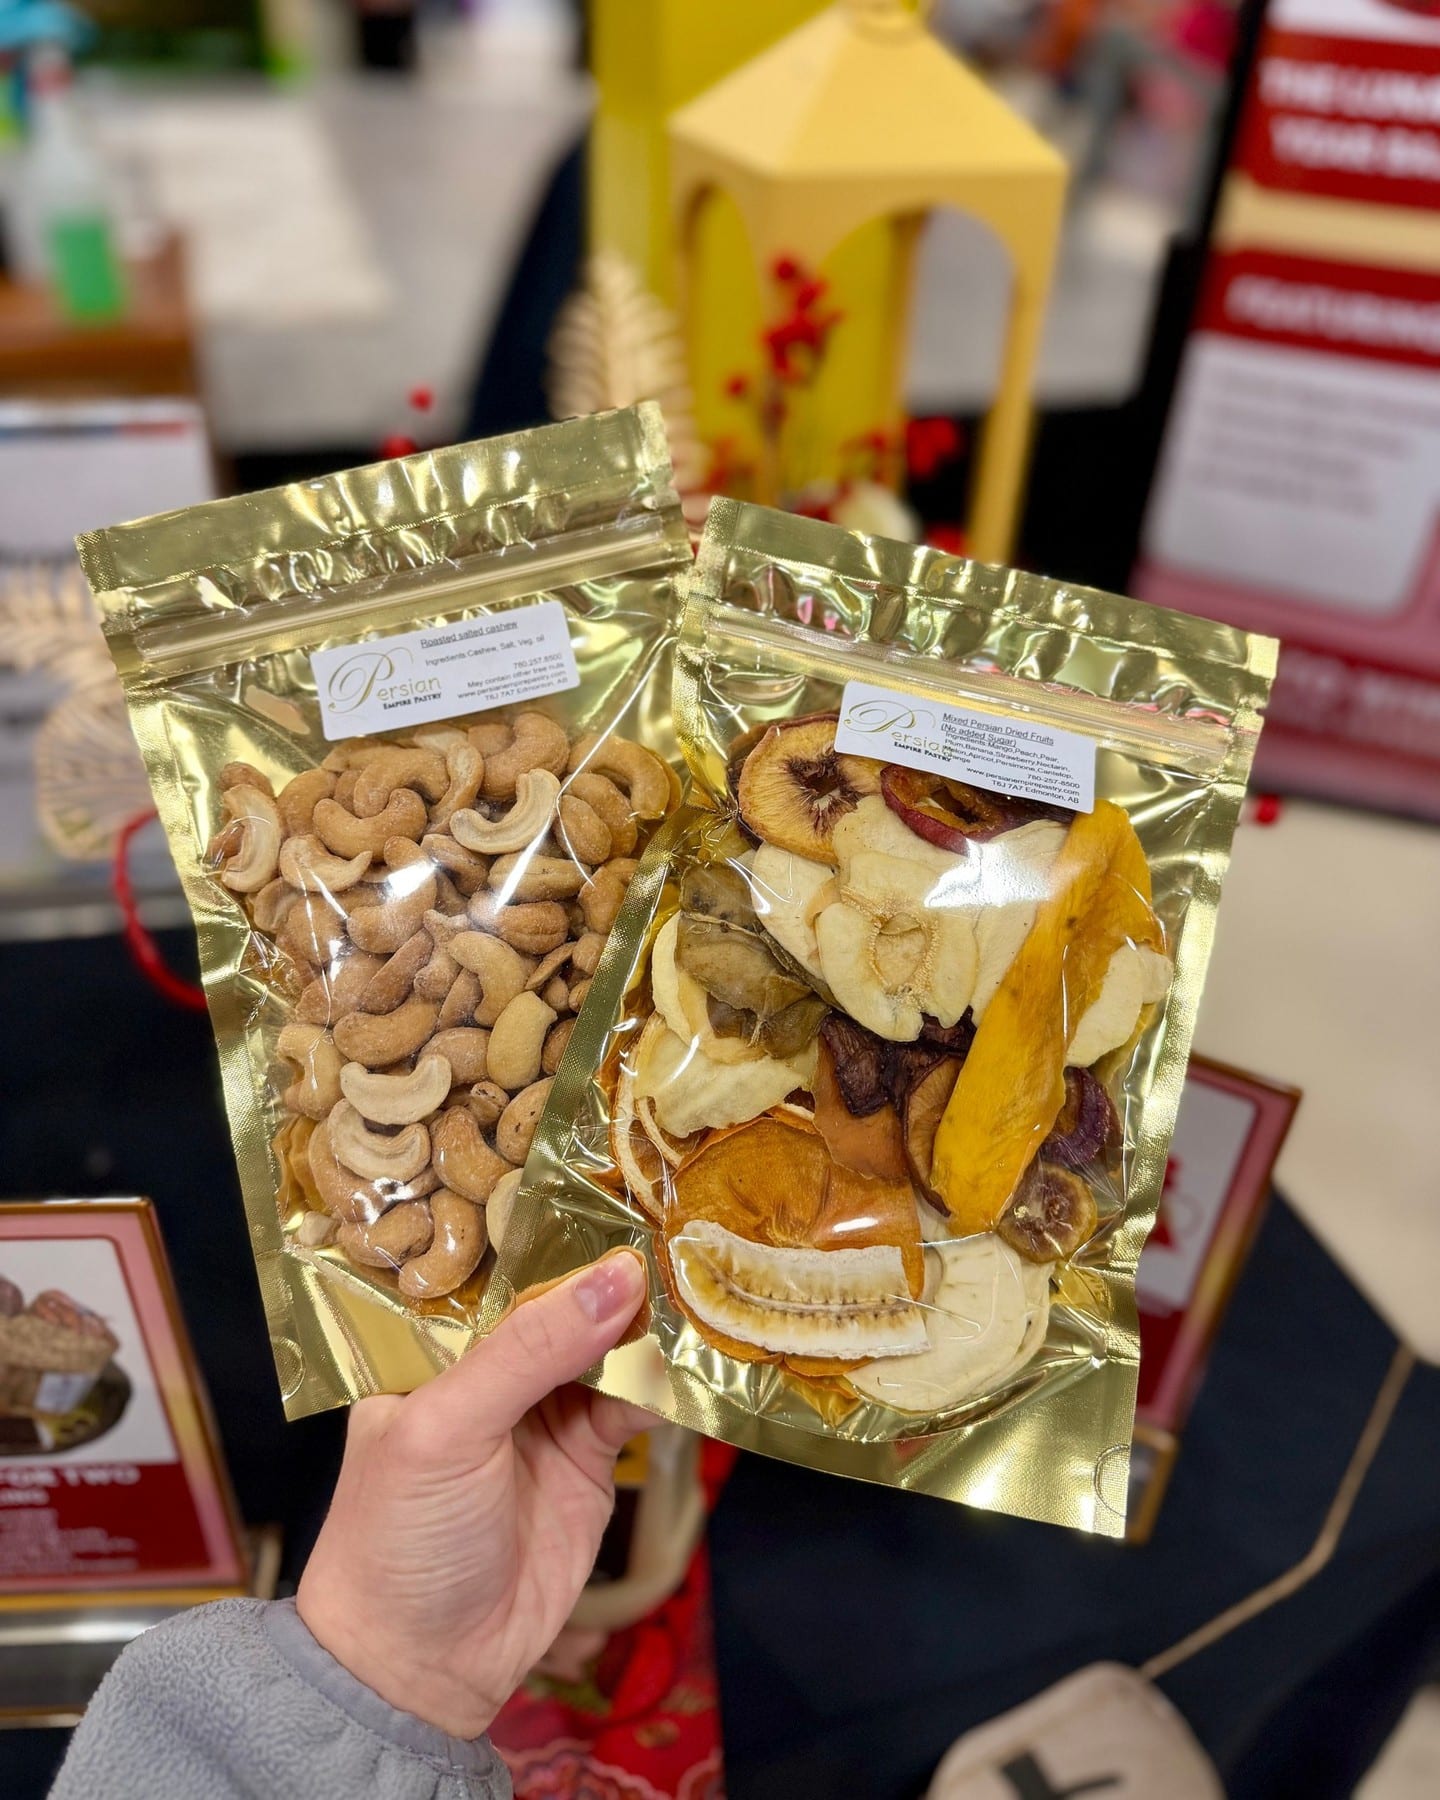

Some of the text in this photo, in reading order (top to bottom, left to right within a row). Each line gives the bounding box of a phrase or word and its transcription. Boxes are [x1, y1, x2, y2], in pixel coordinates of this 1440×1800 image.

[420, 622, 518, 648] Roasted salted cashew
[328, 647, 442, 714] Persian
[383, 692, 442, 710] EMPIRE PASTRY
[940, 723, 1017, 748] (No added Sugar)
[942, 713, 1055, 746] Mixed Persian Dried Fruits
[894, 742, 922, 753] EMPIRE
[966, 767, 1080, 796] www.persianempirepastry.com
[992, 780, 1006, 788] T6J
[1025, 786, 1066, 801] Edmonton,
[1067, 796, 1079, 804] AB
